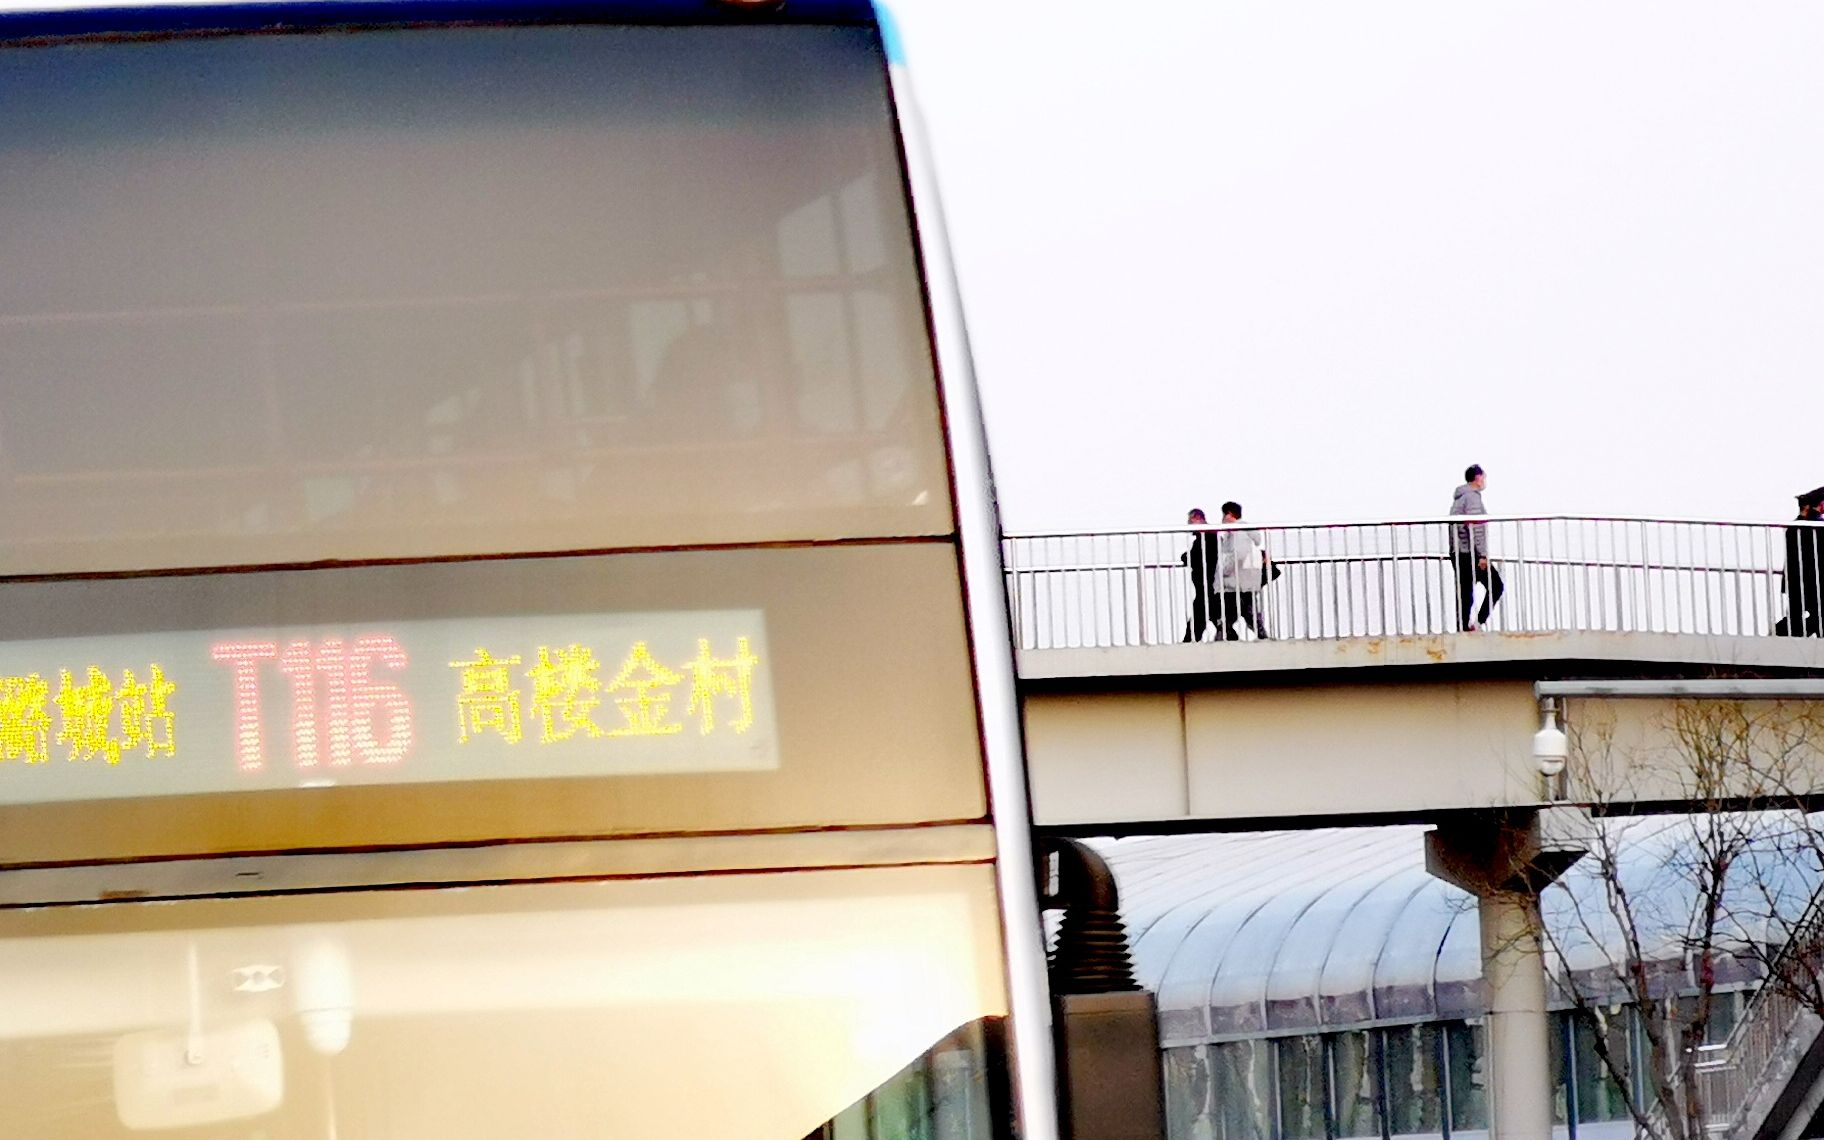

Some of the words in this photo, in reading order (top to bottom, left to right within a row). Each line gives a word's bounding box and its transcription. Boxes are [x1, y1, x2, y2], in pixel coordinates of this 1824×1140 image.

[210, 634, 415, 772] T116
[447, 635, 760, 748] 高楼金村
